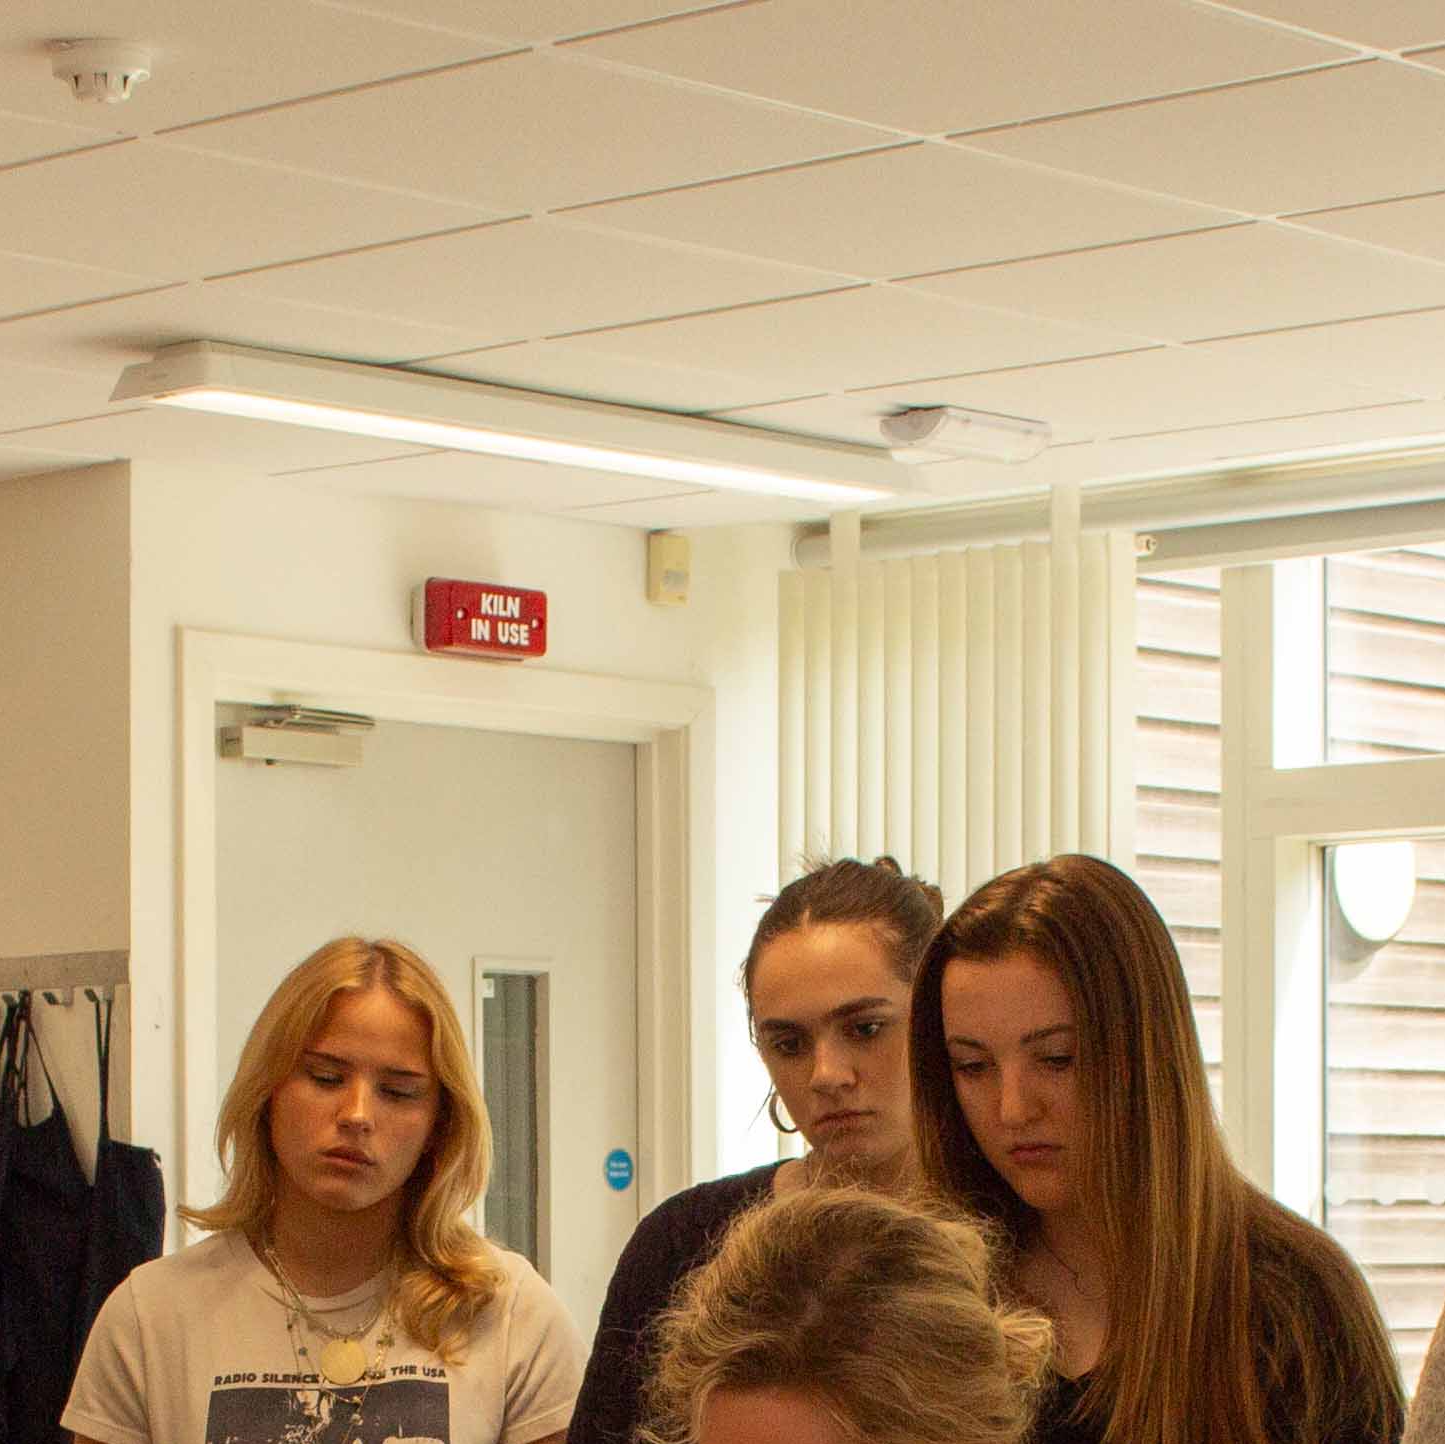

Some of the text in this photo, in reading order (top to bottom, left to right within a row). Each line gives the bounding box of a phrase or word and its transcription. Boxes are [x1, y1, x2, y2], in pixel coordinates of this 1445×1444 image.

[480, 592, 520, 618] KILN
[471, 618, 529, 645] IN USE
[214, 1372, 257, 1386] RADIO
[262, 1373, 320, 1384] SILENCE
[390, 1365, 417, 1376] THE
[422, 1367, 446, 1378] USA
